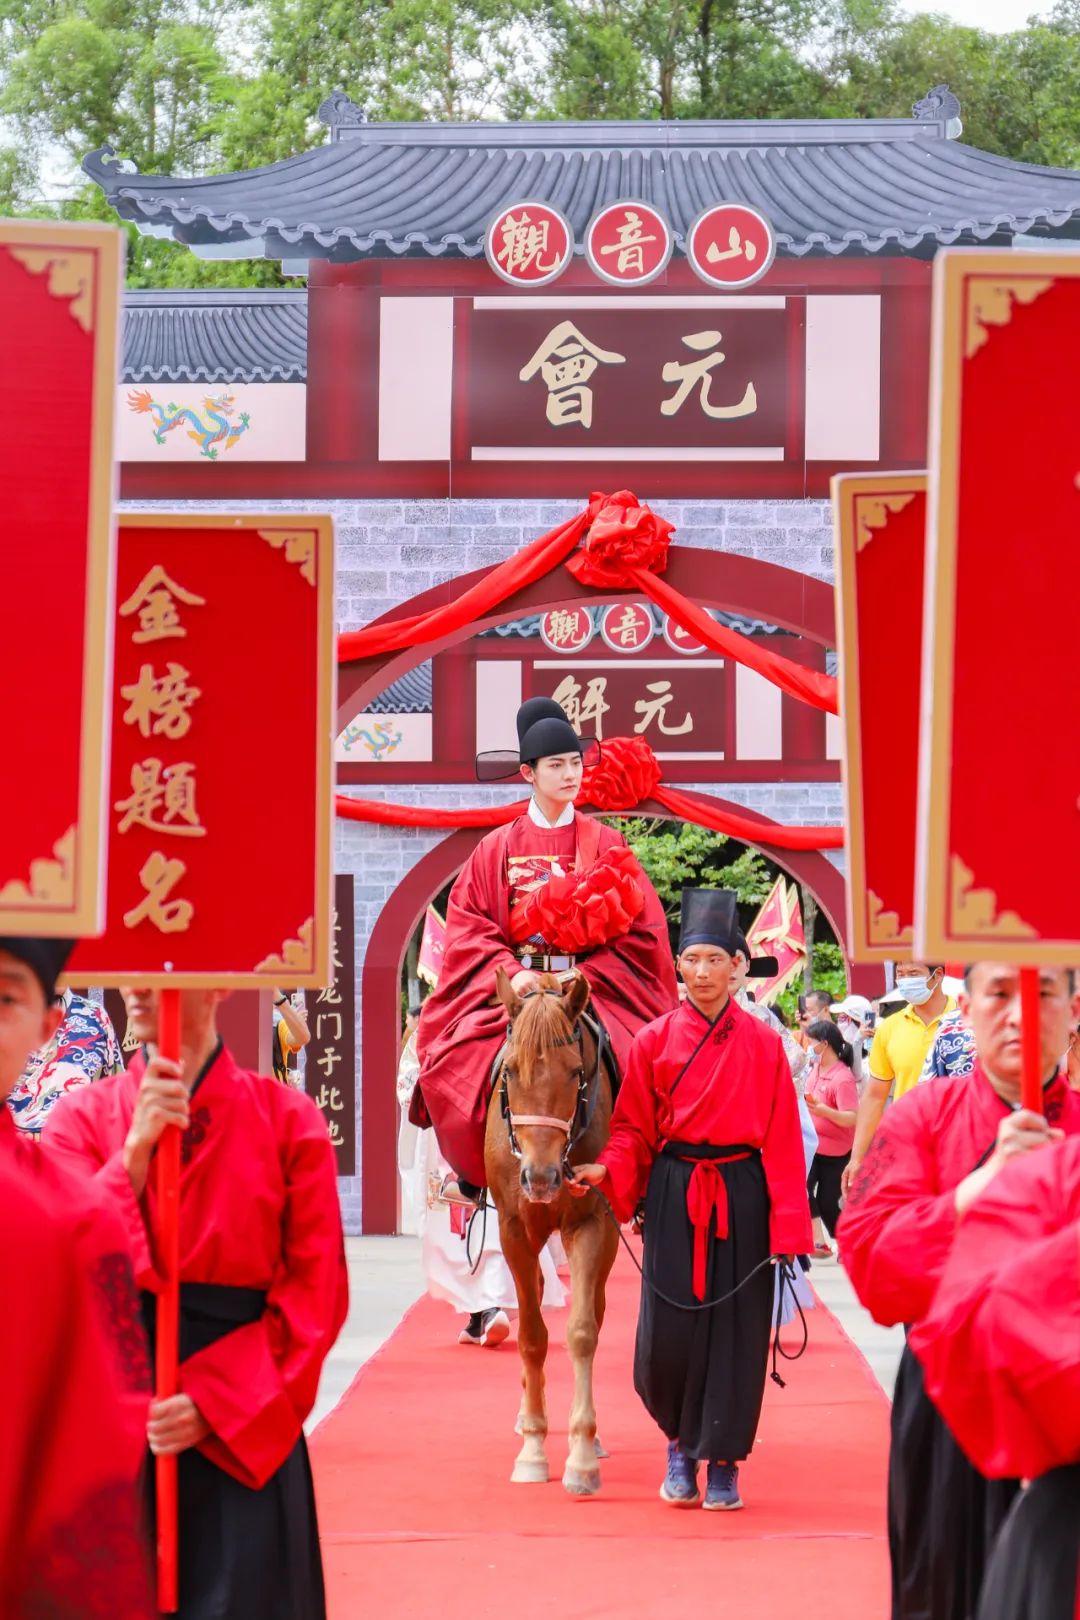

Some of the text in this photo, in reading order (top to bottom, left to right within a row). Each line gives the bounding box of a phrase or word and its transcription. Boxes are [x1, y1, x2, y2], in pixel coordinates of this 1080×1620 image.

[498, 211, 757, 274] 觀音山
[519, 319, 758, 429] 會元
[114, 564, 207, 933] 金榜題名
